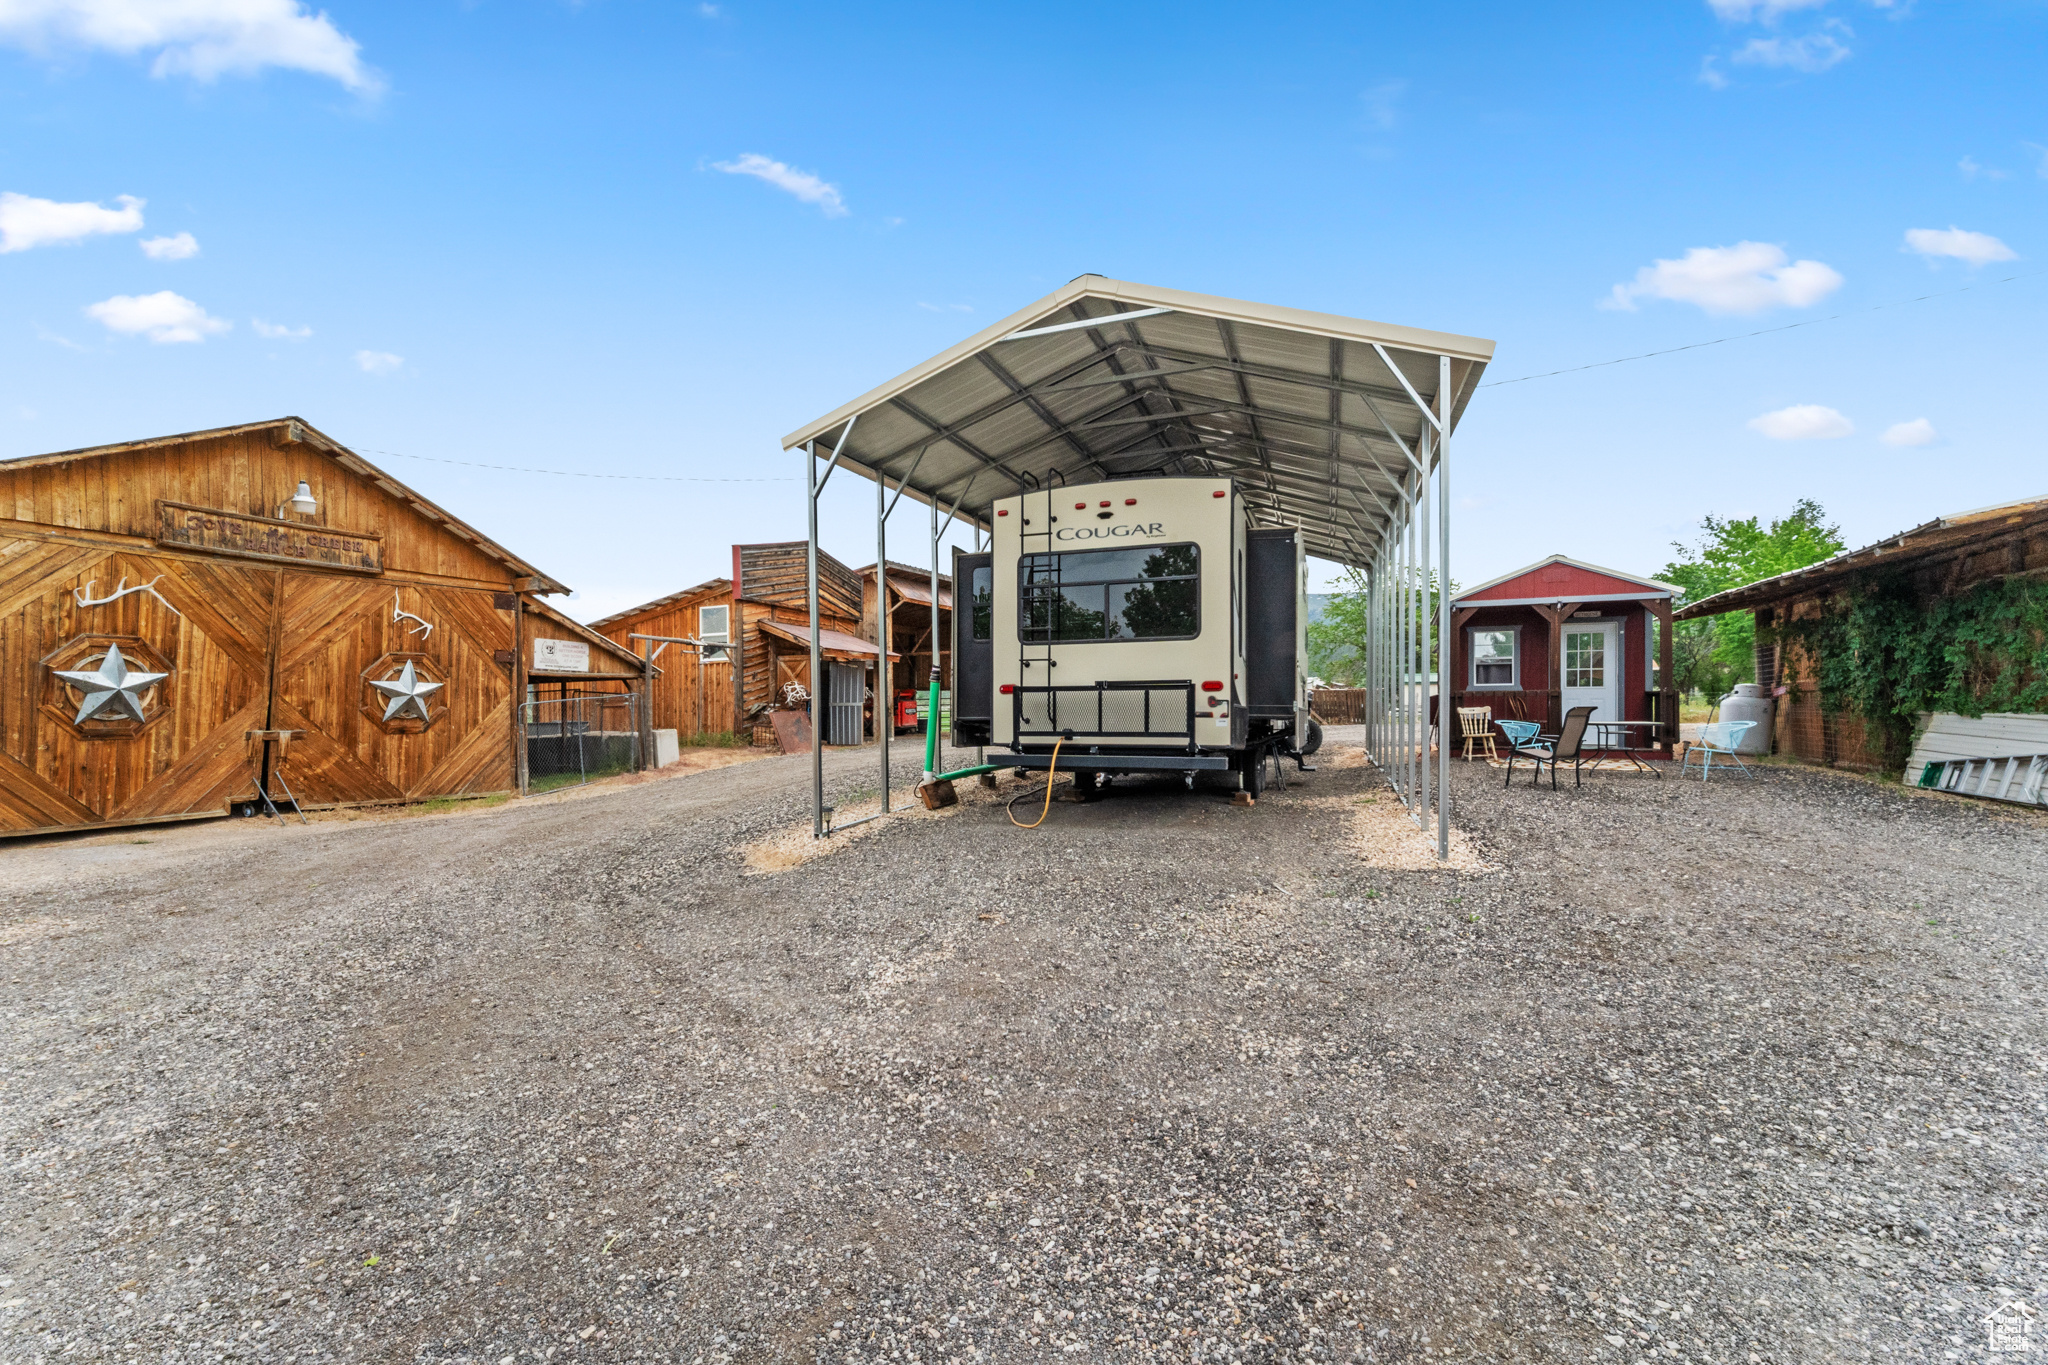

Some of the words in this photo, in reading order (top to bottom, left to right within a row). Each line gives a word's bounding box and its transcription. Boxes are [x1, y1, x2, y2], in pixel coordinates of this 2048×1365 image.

[1056, 522, 1165, 541] COUGAR
[245, 538, 307, 557] RANCH
[306, 534, 364, 553] CREEK
